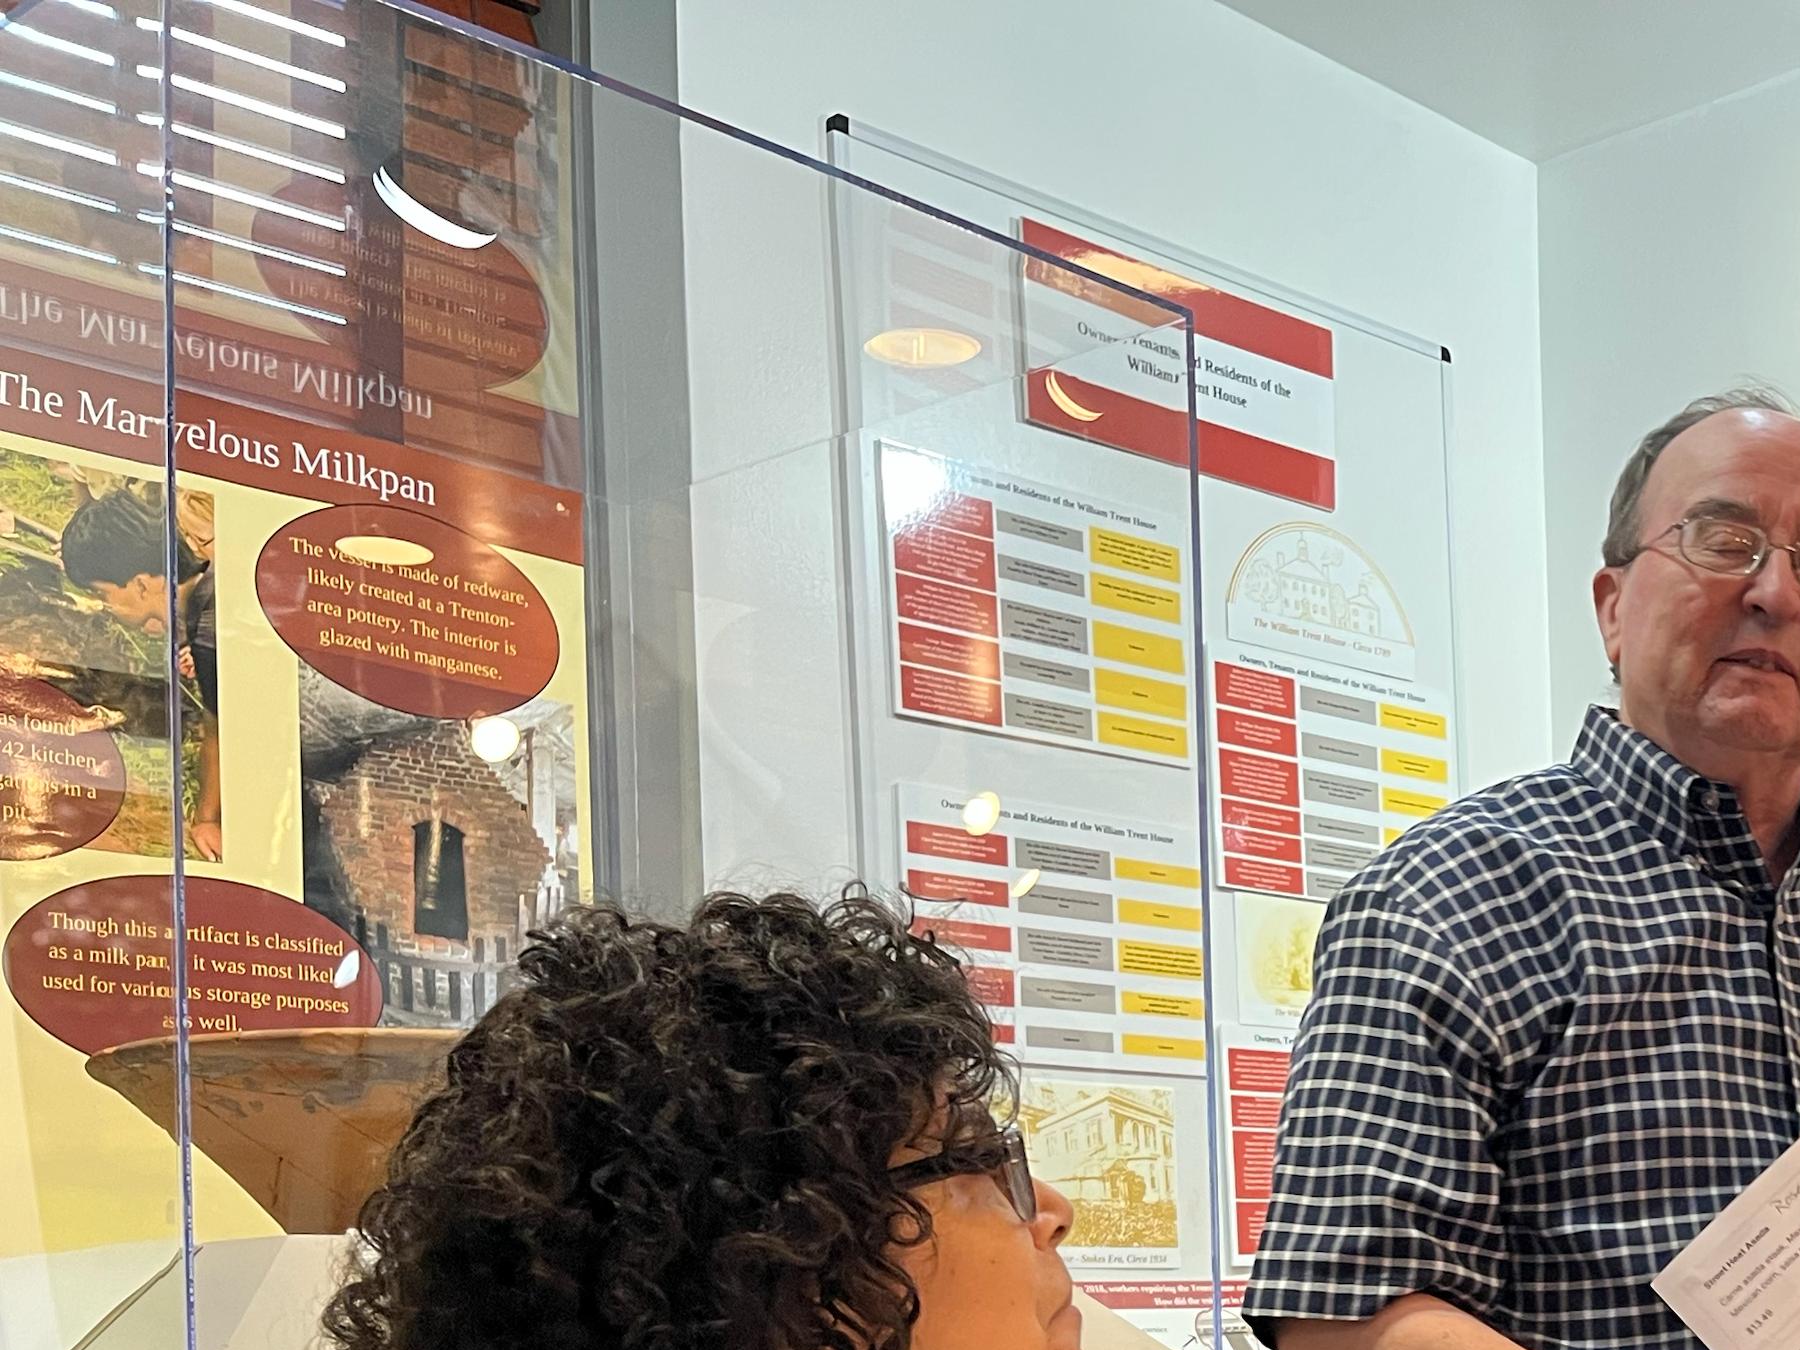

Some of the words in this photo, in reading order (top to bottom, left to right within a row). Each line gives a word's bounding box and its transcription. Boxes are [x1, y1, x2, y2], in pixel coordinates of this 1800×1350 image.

[1206, 359, 1257, 387] Residents
[1261, 378, 1272, 392] of
[1275, 383, 1291, 398] the
[1213, 385, 1247, 407] House
[0, 370, 63, 418] The
[292, 442, 436, 505] Milkpan
[1013, 484, 1051, 502] Residents
[1053, 496, 1060, 504] of
[1063, 498, 1075, 508] the
[1077, 502, 1107, 518] William
[1110, 510, 1131, 524] Trent
[1134, 517, 1157, 529] House
[289, 537, 323, 558] The
[398, 566, 439, 585] made
[444, 575, 461, 589] of
[464, 582, 528, 608] redware,
[307, 568, 354, 594] likely
[359, 582, 414, 606] created
[418, 597, 432, 611] at
[436, 602, 444, 613] a
[449, 601, 515, 628] Trenton-
[307, 600, 341, 616] area
[347, 607, 405, 634] pottery.
[410, 619, 439, 639] The
[444, 627, 499, 652] interior
[504, 640, 517, 656] is
[1254, 617, 1267, 628] The
[1271, 621, 1299, 636] William
[1302, 629, 1321, 641] Trent
[1324, 634, 1346, 646] House
[320, 628, 371, 651] glazed
[376, 641, 410, 660] with
[414, 650, 502, 680] manganese.
[24, 712, 75, 736] found
[31, 744, 96, 768] kitchen
[65, 780, 80, 797] in
[87, 787, 96, 799] a
[1013, 812, 1028, 821] and
[1030, 813, 1068, 827] Residents
[1071, 818, 1078, 827] of
[1080, 820, 1092, 830] the
[1095, 824, 1125, 837] William
[1127, 829, 1147, 840] Trent
[1150, 833, 1174, 844] House
[48, 911, 118, 938] Though
[125, 920, 157, 939] this
[246, 931, 260, 947] is
[265, 934, 343, 956] classified
[48, 945, 68, 960] as
[73, 948, 83, 961] a
[88, 945, 130, 966] milk
[193, 955, 205, 970] it
[211, 959, 246, 975] was
[251, 961, 293, 980] most
[298, 964, 338, 988] likel
[42, 974, 84, 992] used
[91, 975, 116, 993] for
[207, 986, 272, 1009] storage
[276, 994, 349, 1014] purposes
[199, 1016, 242, 1032] well.
